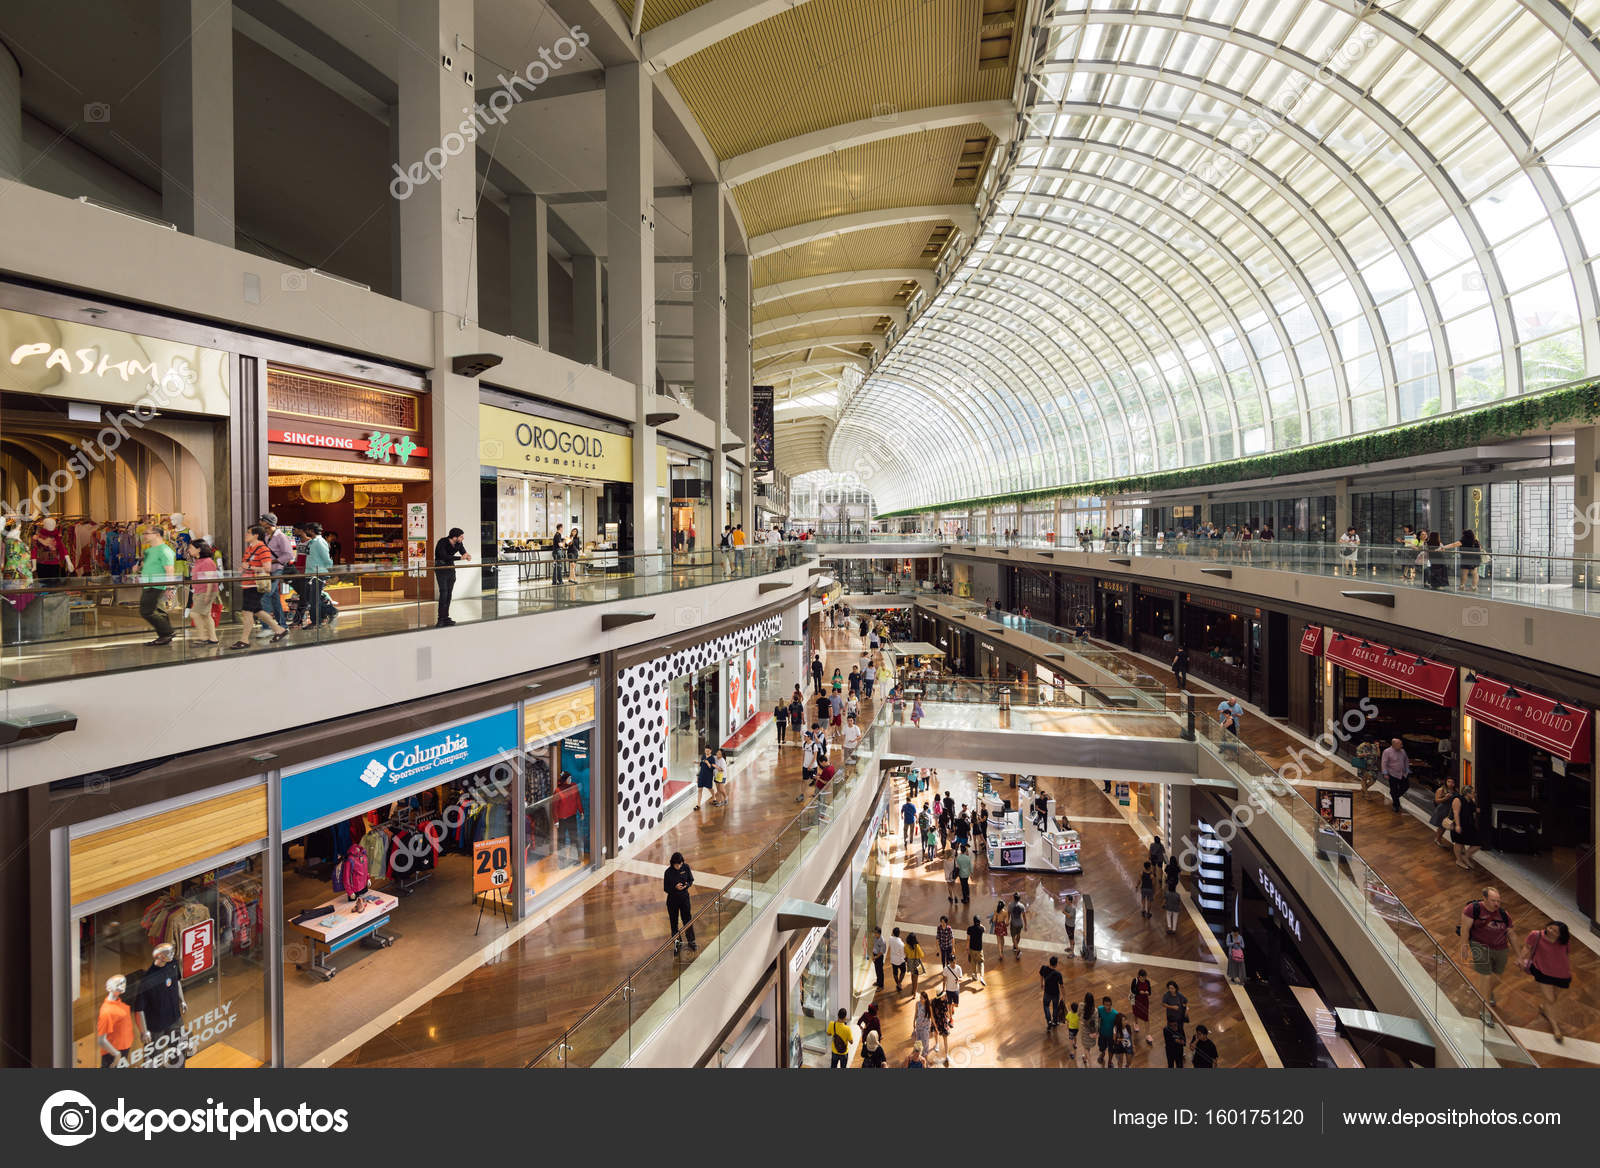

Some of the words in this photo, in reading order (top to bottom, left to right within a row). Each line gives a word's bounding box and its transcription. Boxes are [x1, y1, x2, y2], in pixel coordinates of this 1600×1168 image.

[283, 432, 353, 449] SINCHONG
[365, 430, 416, 465] 新中
[525, 454, 596, 470] cosmetics
[1351, 647, 1380, 665] FRENCH
[1382, 659, 1415, 676] BISTRO
[1474, 687, 1512, 711] DANIEL
[1524, 705, 1573, 733] BOULUD
[388, 733, 468, 771] Columbia
[389, 763, 432, 784] Sportswear
[477, 847, 507, 875] 20
[494, 874, 504, 884] 10
[1259, 868, 1301, 942] SEPHORA
[191, 928, 206, 972] OutDry
[117, 1000, 232, 1068] ABSOLUTELY
